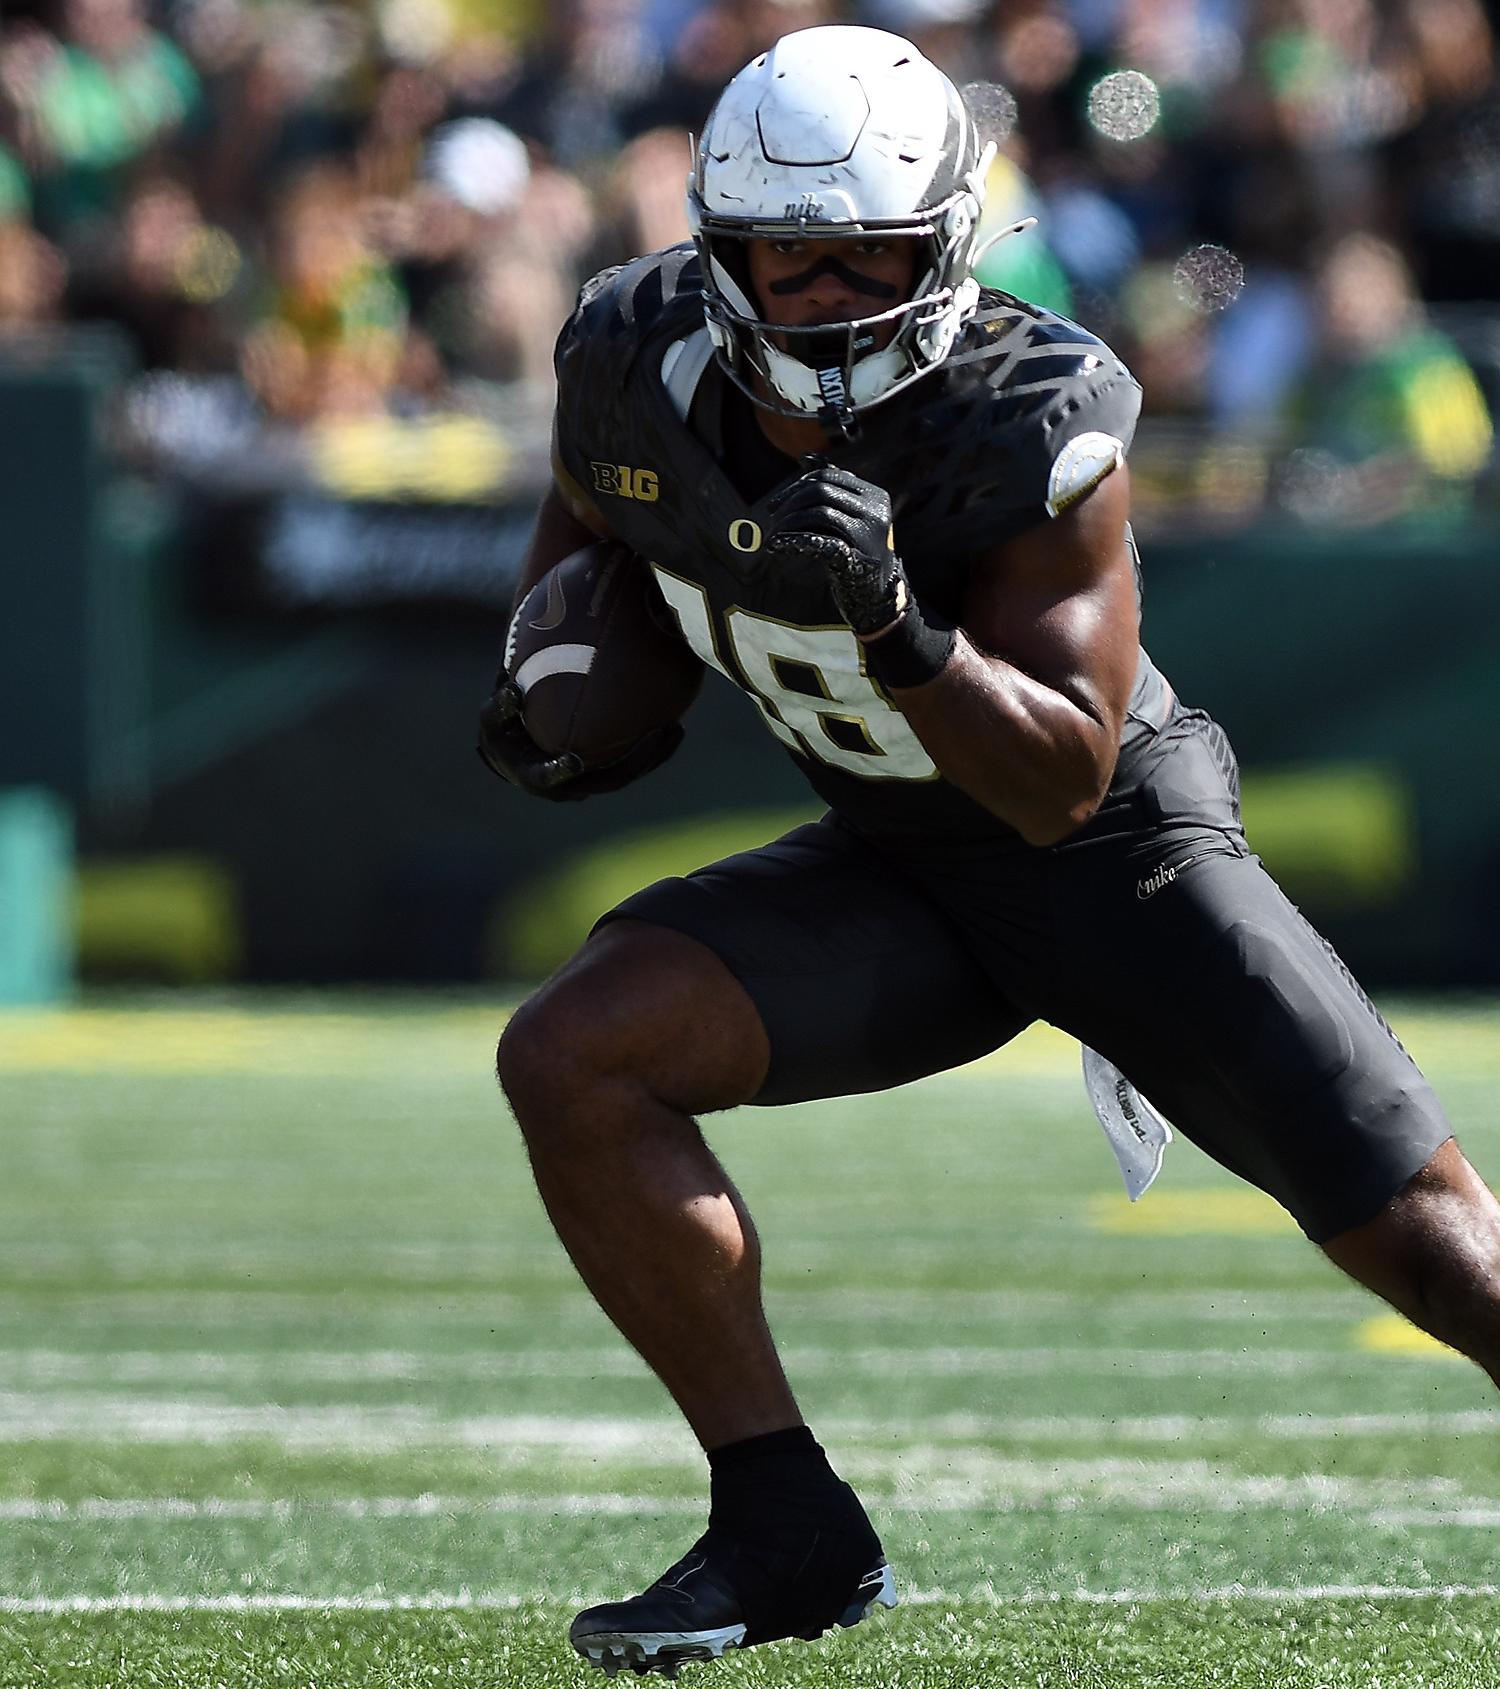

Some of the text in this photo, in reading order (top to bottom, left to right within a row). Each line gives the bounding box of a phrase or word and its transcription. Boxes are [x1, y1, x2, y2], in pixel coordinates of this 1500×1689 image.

[784, 192, 824, 219] nike
[728, 518, 762, 552] O
[649, 562, 941, 783] 18
[1142, 862, 1178, 895] nike
